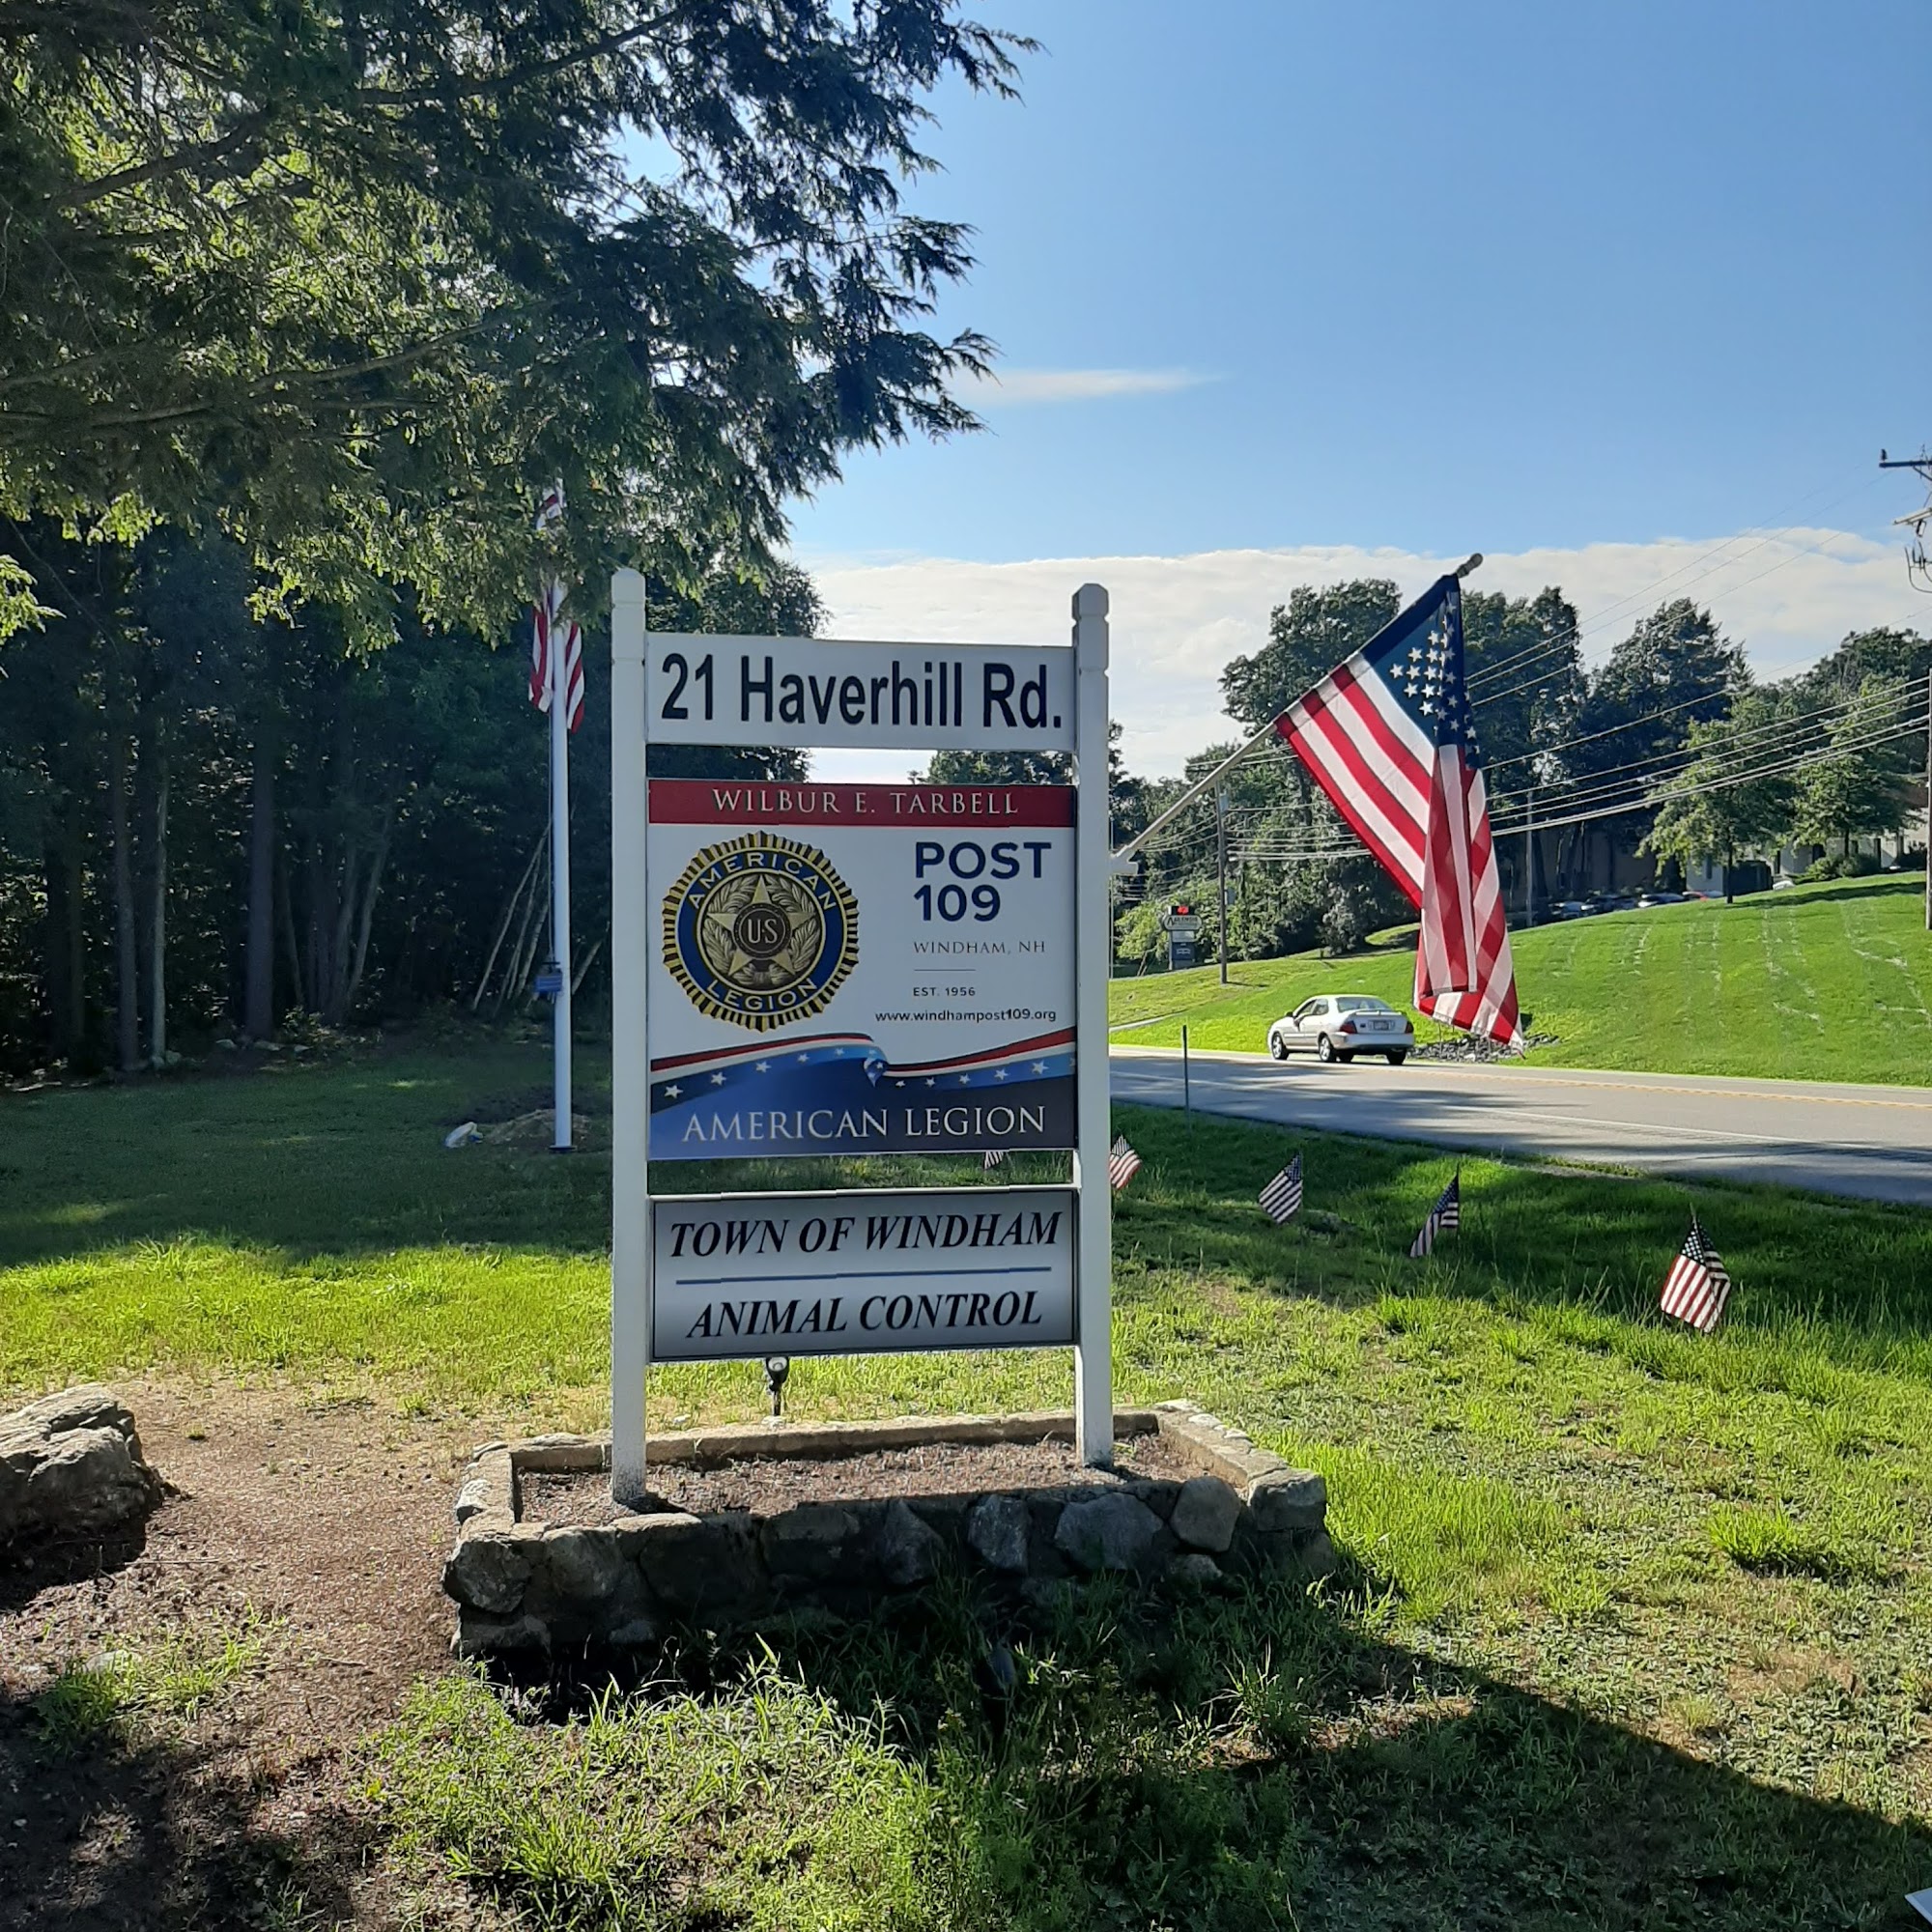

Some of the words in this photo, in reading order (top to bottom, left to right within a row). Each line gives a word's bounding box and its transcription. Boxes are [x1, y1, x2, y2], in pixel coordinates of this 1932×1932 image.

[661, 652, 714, 721] 21
[740, 655, 963, 727] Haverhill
[982, 662, 1063, 728] Rd.
[712, 788, 841, 814] WILBUR
[855, 792, 875, 814] E.
[890, 791, 1019, 815] TARBELL
[915, 841, 1052, 880] POST
[688, 851, 838, 910] AMERICAN
[913, 884, 1001, 922] 109
[914, 940, 1011, 955] WINDHAM,
[1018, 940, 1046, 953] NH
[706, 979, 819, 1010] LEGION
[913, 986, 940, 997] EST.
[945, 986, 976, 997] 1956
[875, 1008, 1057, 1023] www.windhampost109.org
[681, 1108, 888, 1143] AMERICAN
[904, 1105, 1046, 1137] LEGION
[670, 1219, 789, 1257] TOWN
[798, 1217, 856, 1252] OF
[867, 1211, 1063, 1250] WINDHAM
[685, 1298, 848, 1339] ANIMAL
[859, 1291, 1042, 1330] CONTROL
